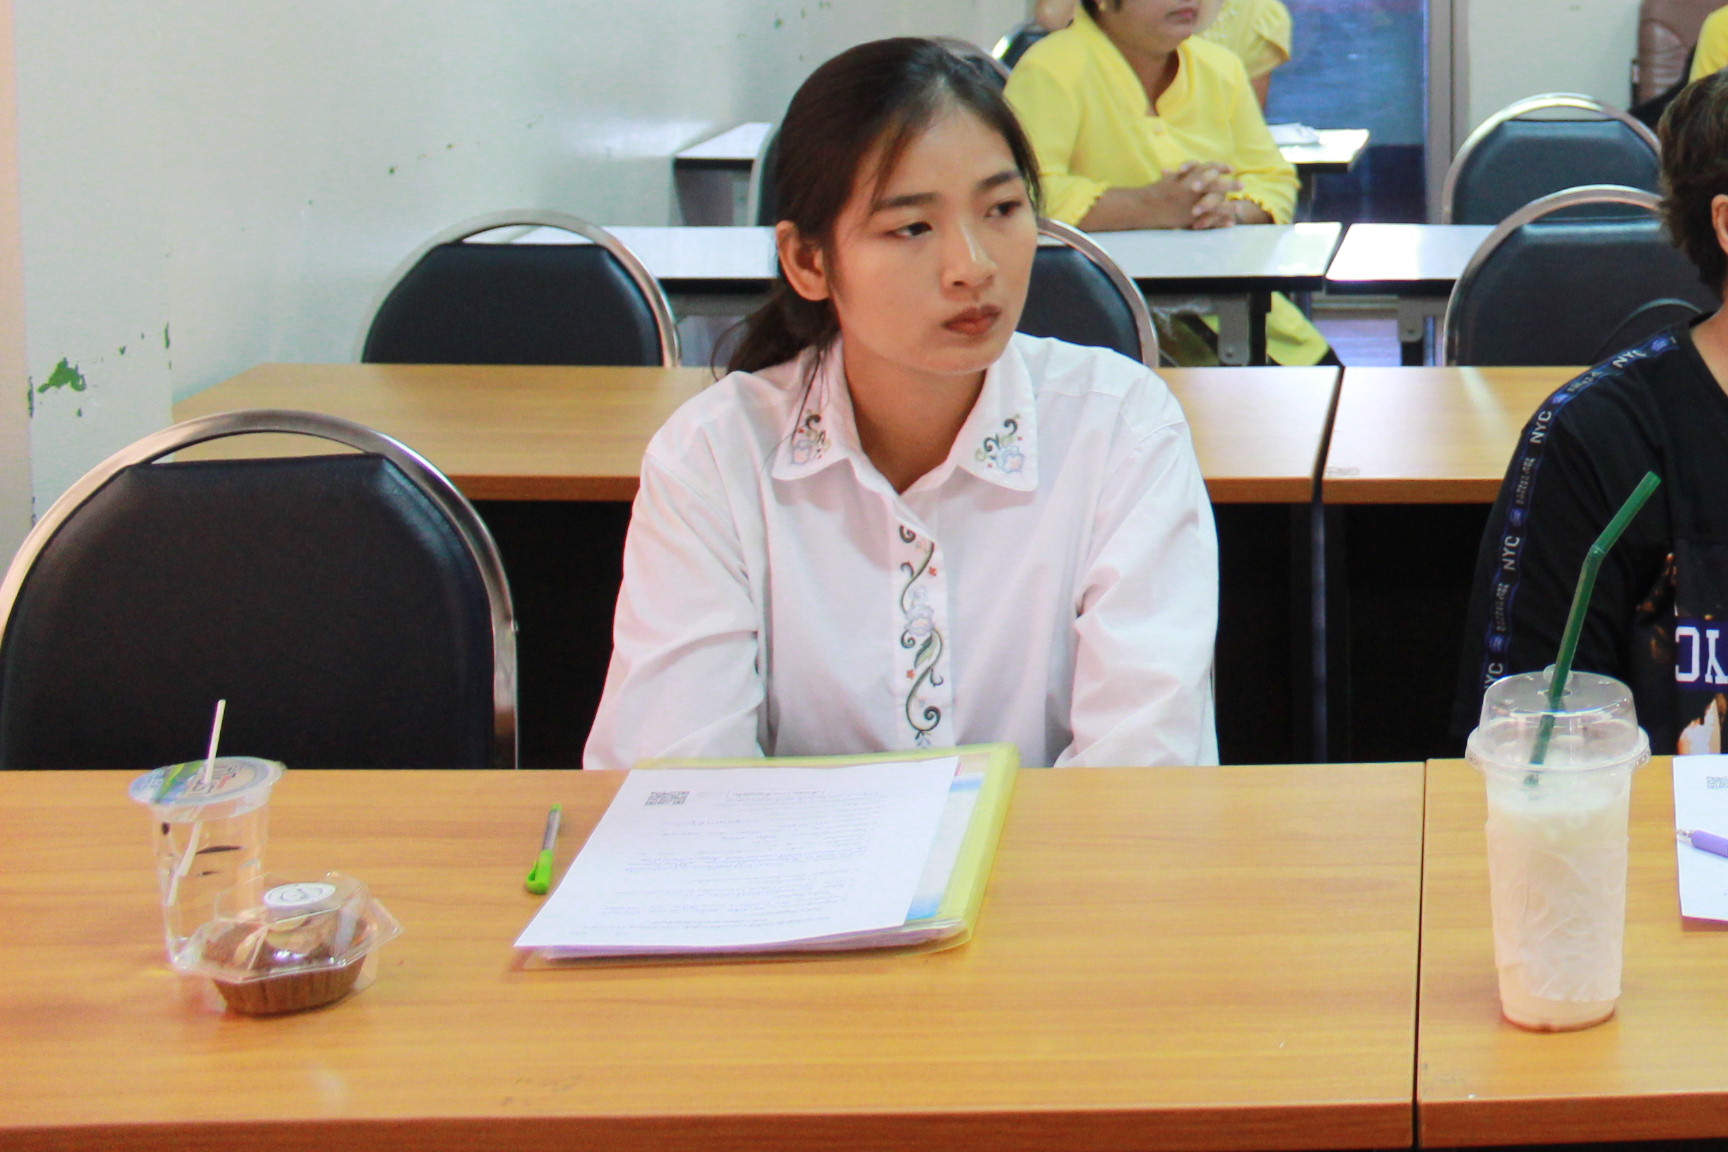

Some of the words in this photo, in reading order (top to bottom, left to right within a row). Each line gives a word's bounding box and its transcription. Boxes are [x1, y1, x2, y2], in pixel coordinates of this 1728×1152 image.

[1612, 350, 1647, 368] NYC
[1530, 410, 1552, 444] NYC
[1503, 535, 1521, 572] NYC
